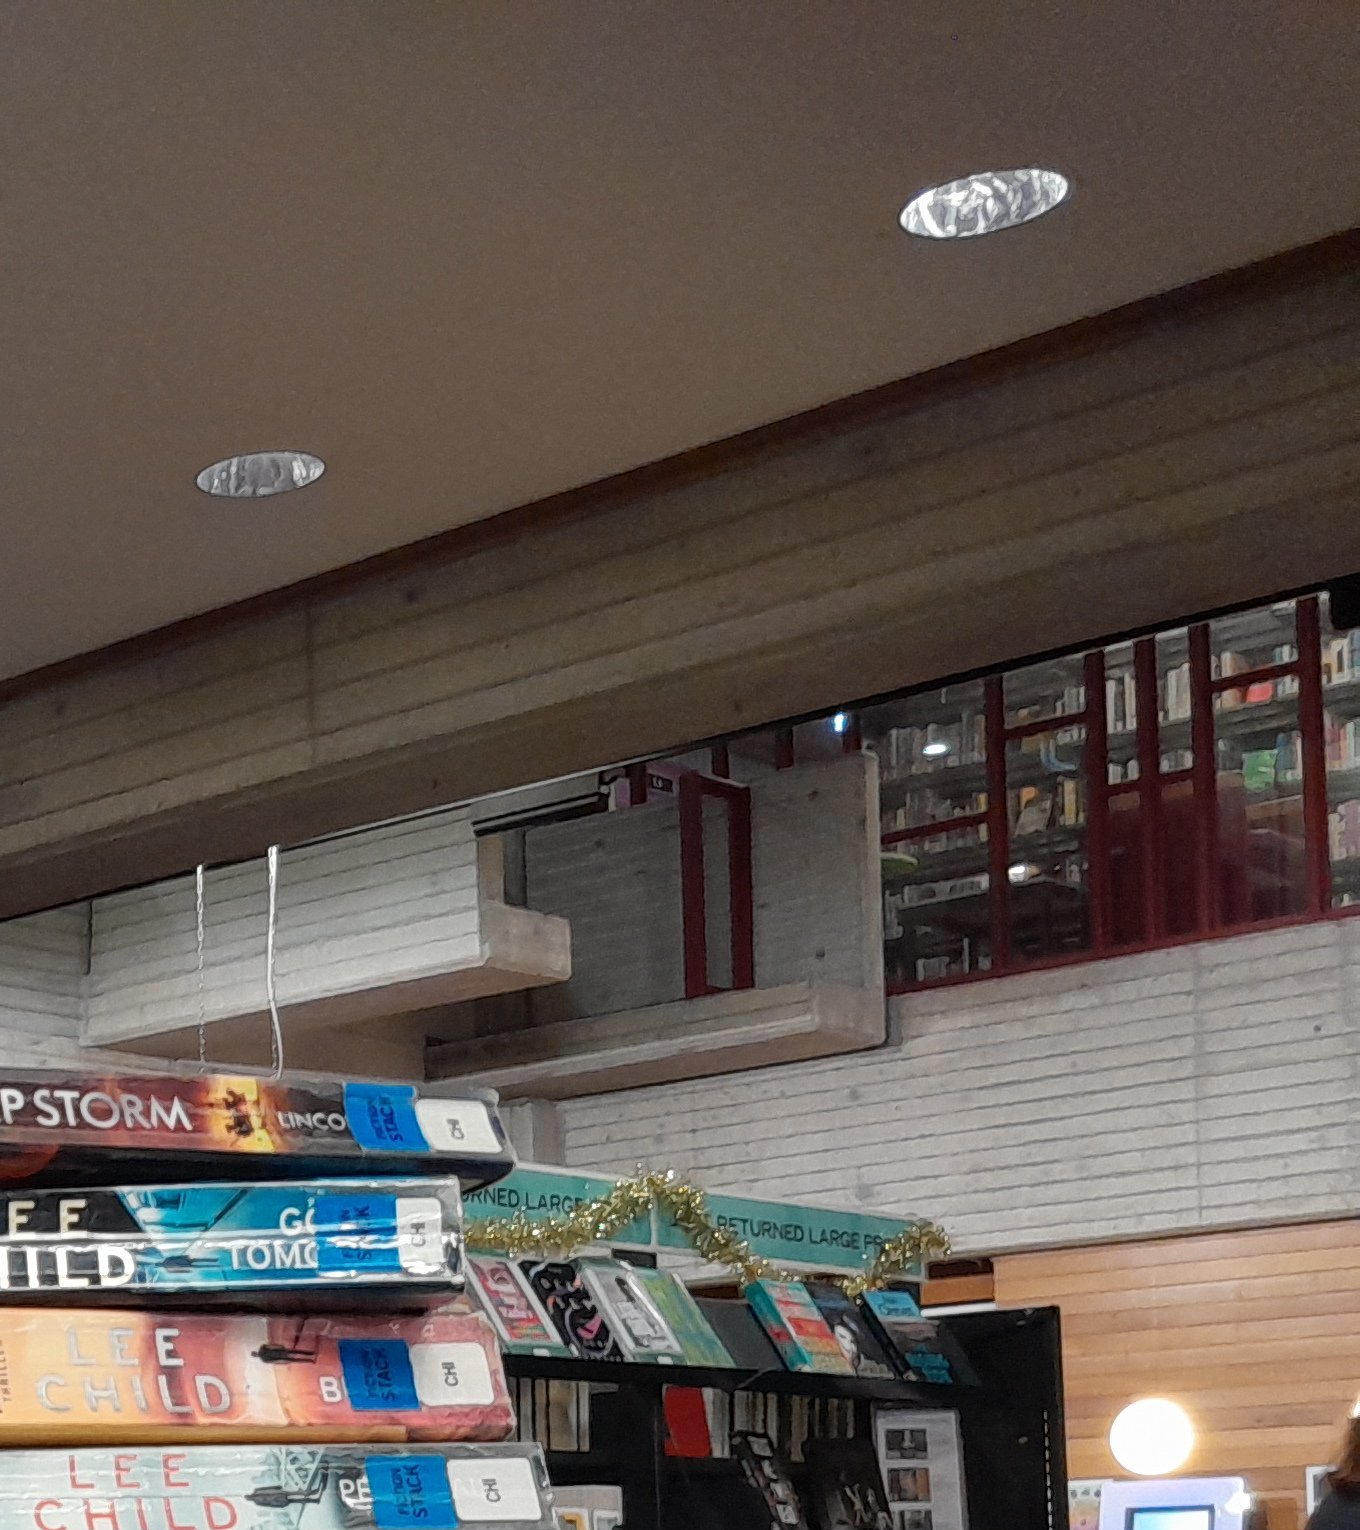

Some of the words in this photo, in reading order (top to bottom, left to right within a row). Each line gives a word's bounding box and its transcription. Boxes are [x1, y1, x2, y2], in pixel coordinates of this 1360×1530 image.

[33, 1089, 195, 1132] STORM
[716, 1214, 804, 1243] RETURNED
[809, 1227, 859, 1249] LARGE
[67, 1327, 182, 1368] LEE
[441, 1361, 459, 1388] CHI
[34, 1375, 231, 1416] CHILD
[67, 1452, 191, 1490] LEE
[482, 1478, 502, 1503] CHI
[402, 1464, 429, 1519] STACK
